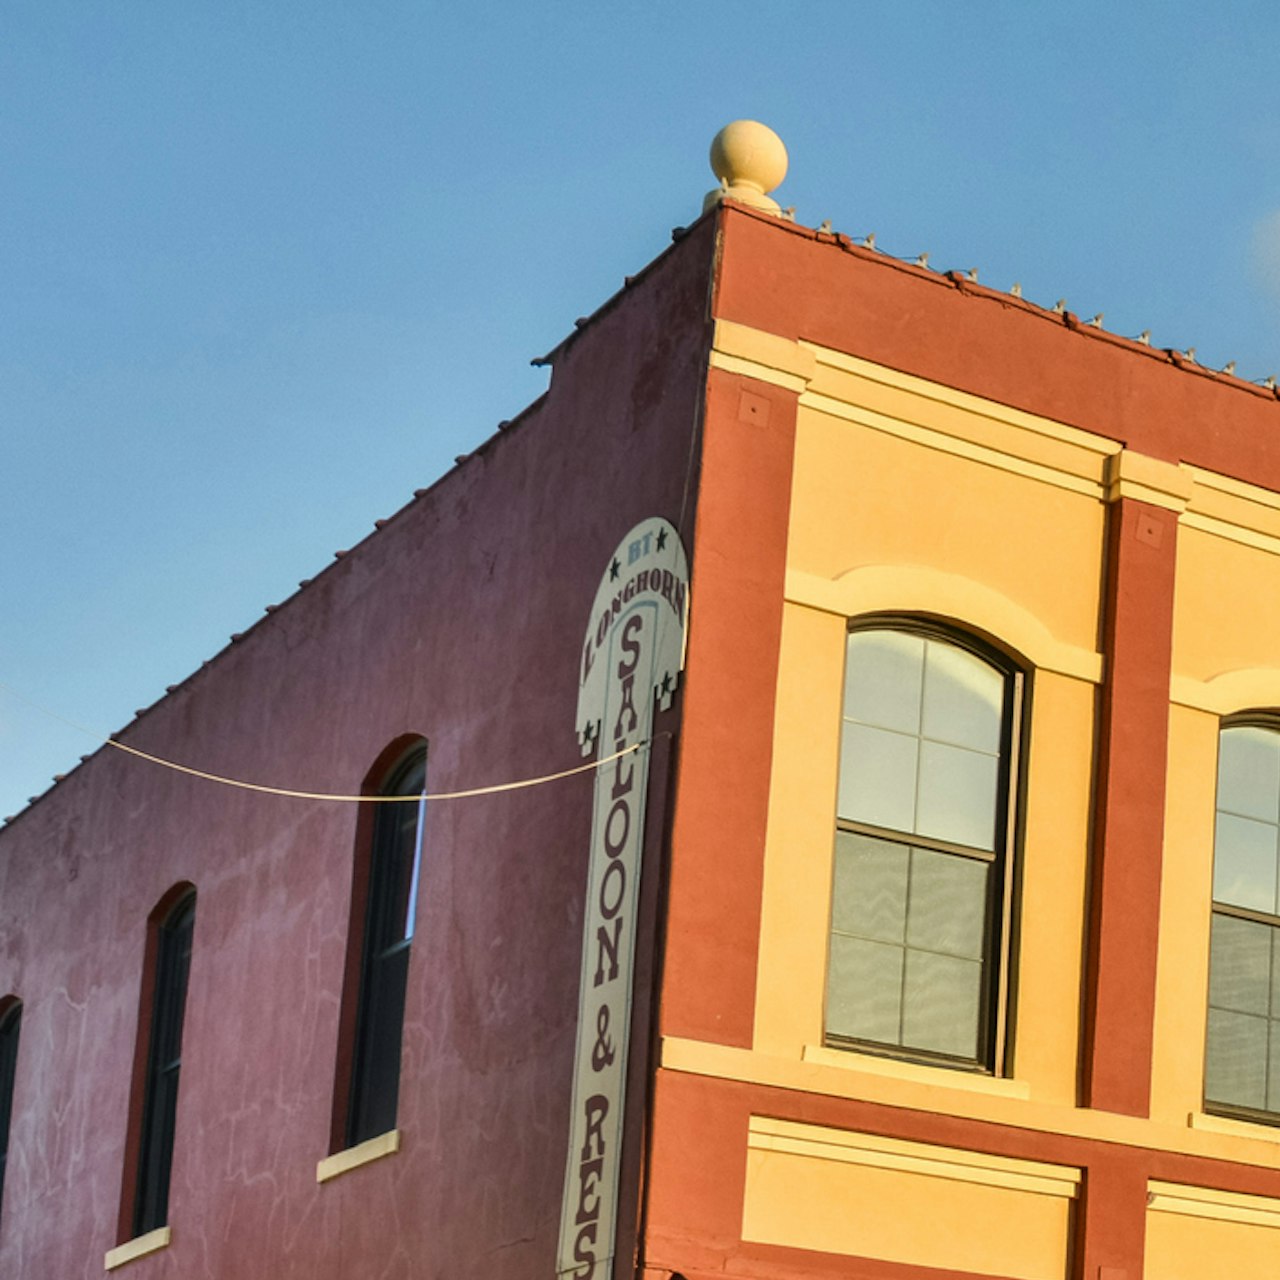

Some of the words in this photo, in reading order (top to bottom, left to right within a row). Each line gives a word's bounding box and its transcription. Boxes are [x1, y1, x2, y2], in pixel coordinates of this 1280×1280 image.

[627, 531, 654, 567] BT
[582, 568, 686, 686] LONGHORN
[593, 613, 643, 989] SALOON
[590, 1003, 615, 1072] &
